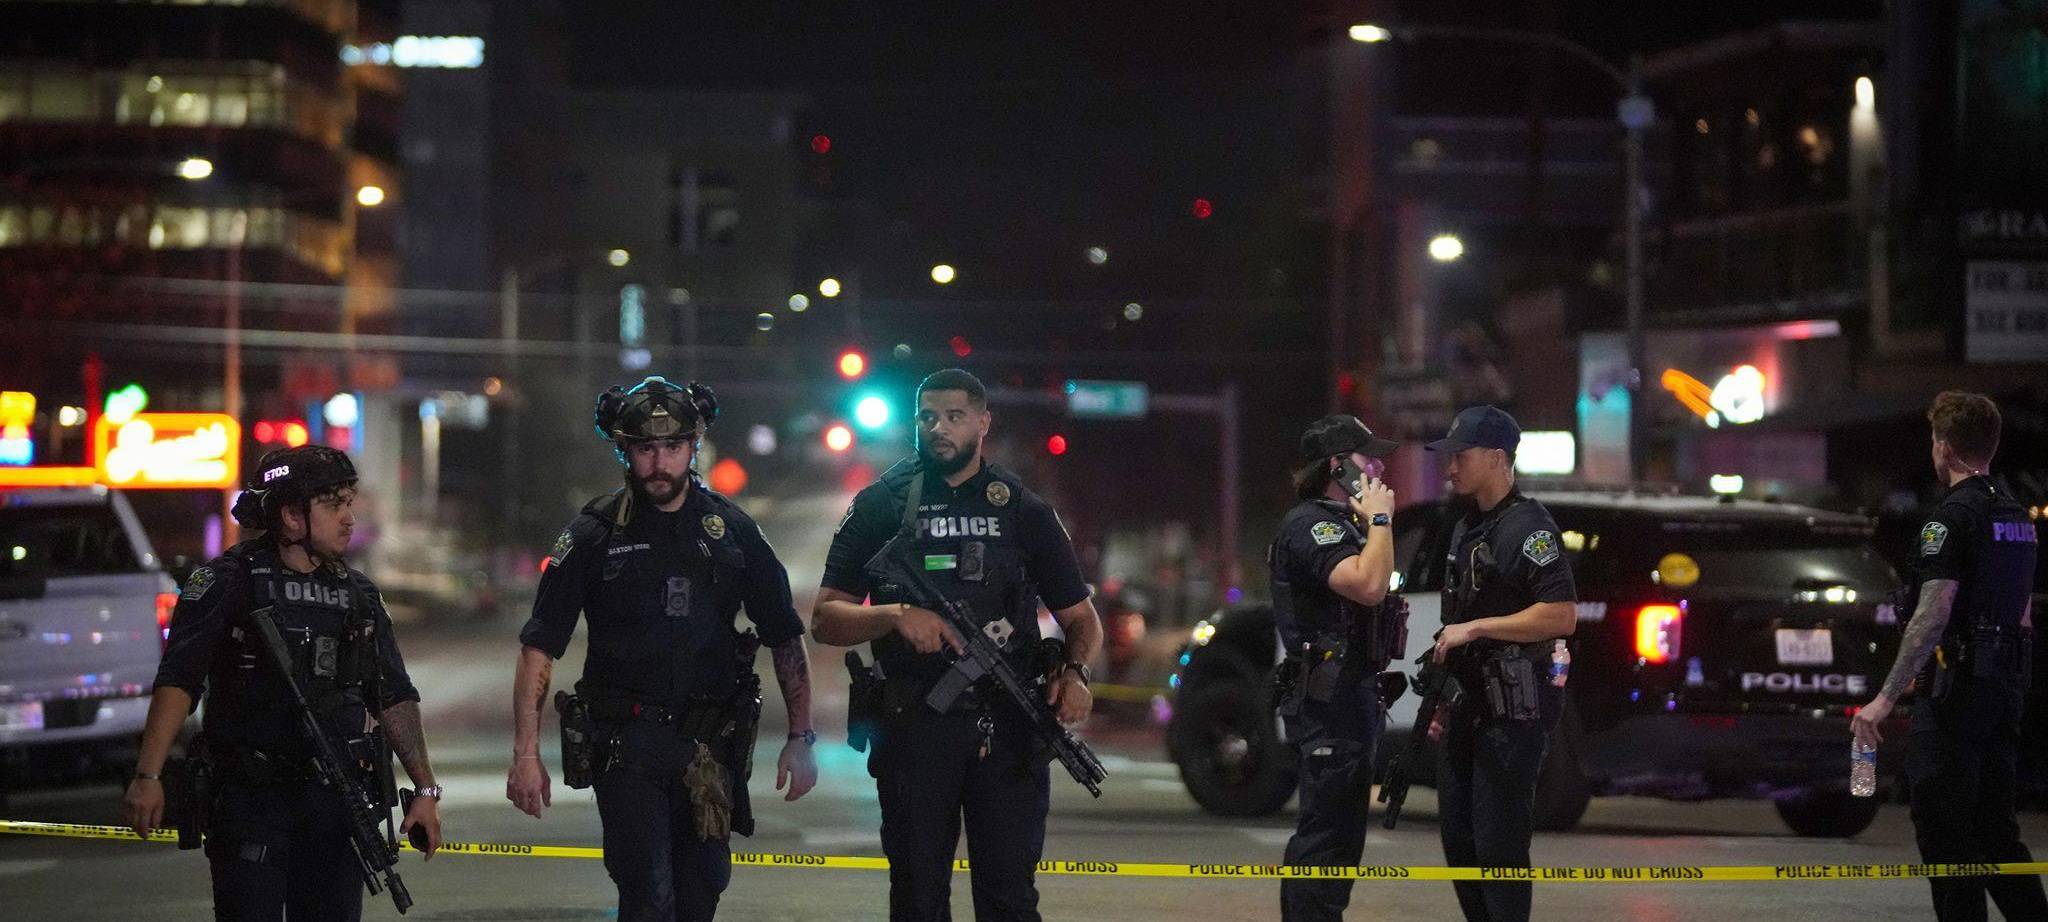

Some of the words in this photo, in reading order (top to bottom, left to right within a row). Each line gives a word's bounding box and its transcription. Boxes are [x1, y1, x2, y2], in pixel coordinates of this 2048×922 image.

[914, 516, 1002, 538] POLICE
[1741, 673, 1868, 695] POLICE
[1034, 861, 1056, 871] OT
[1190, 864, 1244, 875] POLICE
[1251, 864, 1284, 876] LINE
[1291, 865, 1311, 876] DO
[1322, 865, 1347, 877] NOT
[1357, 866, 1408, 878] CROSS
[1480, 867, 1536, 879] POLICE
[1543, 867, 1577, 879] LINE
[1584, 867, 1604, 879] DO
[1612, 867, 1641, 879] NOT
[1650, 867, 1703, 879] CROSS
